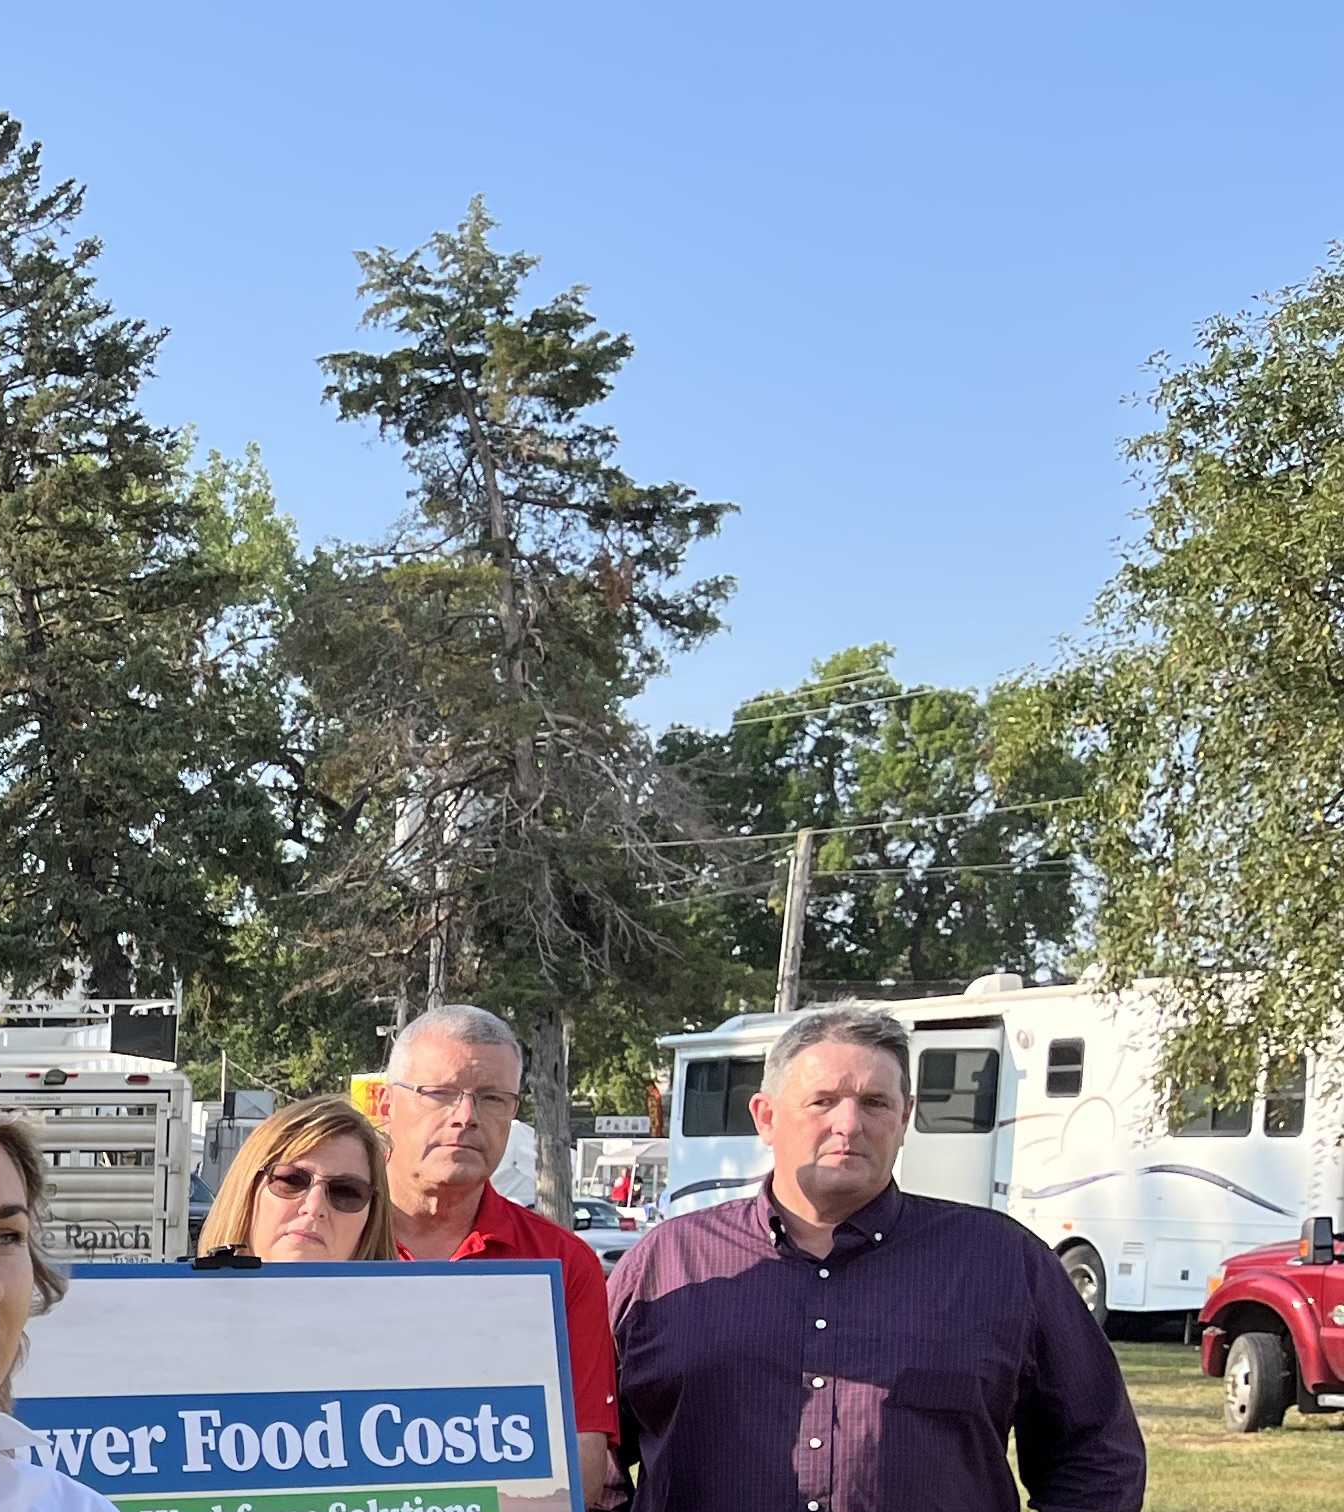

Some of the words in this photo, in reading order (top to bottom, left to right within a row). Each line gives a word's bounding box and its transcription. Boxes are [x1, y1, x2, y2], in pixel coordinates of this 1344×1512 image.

[65, 1224, 150, 1249] Ranch
[179, 1401, 347, 1471] Food
[361, 1404, 533, 1466] Costs
